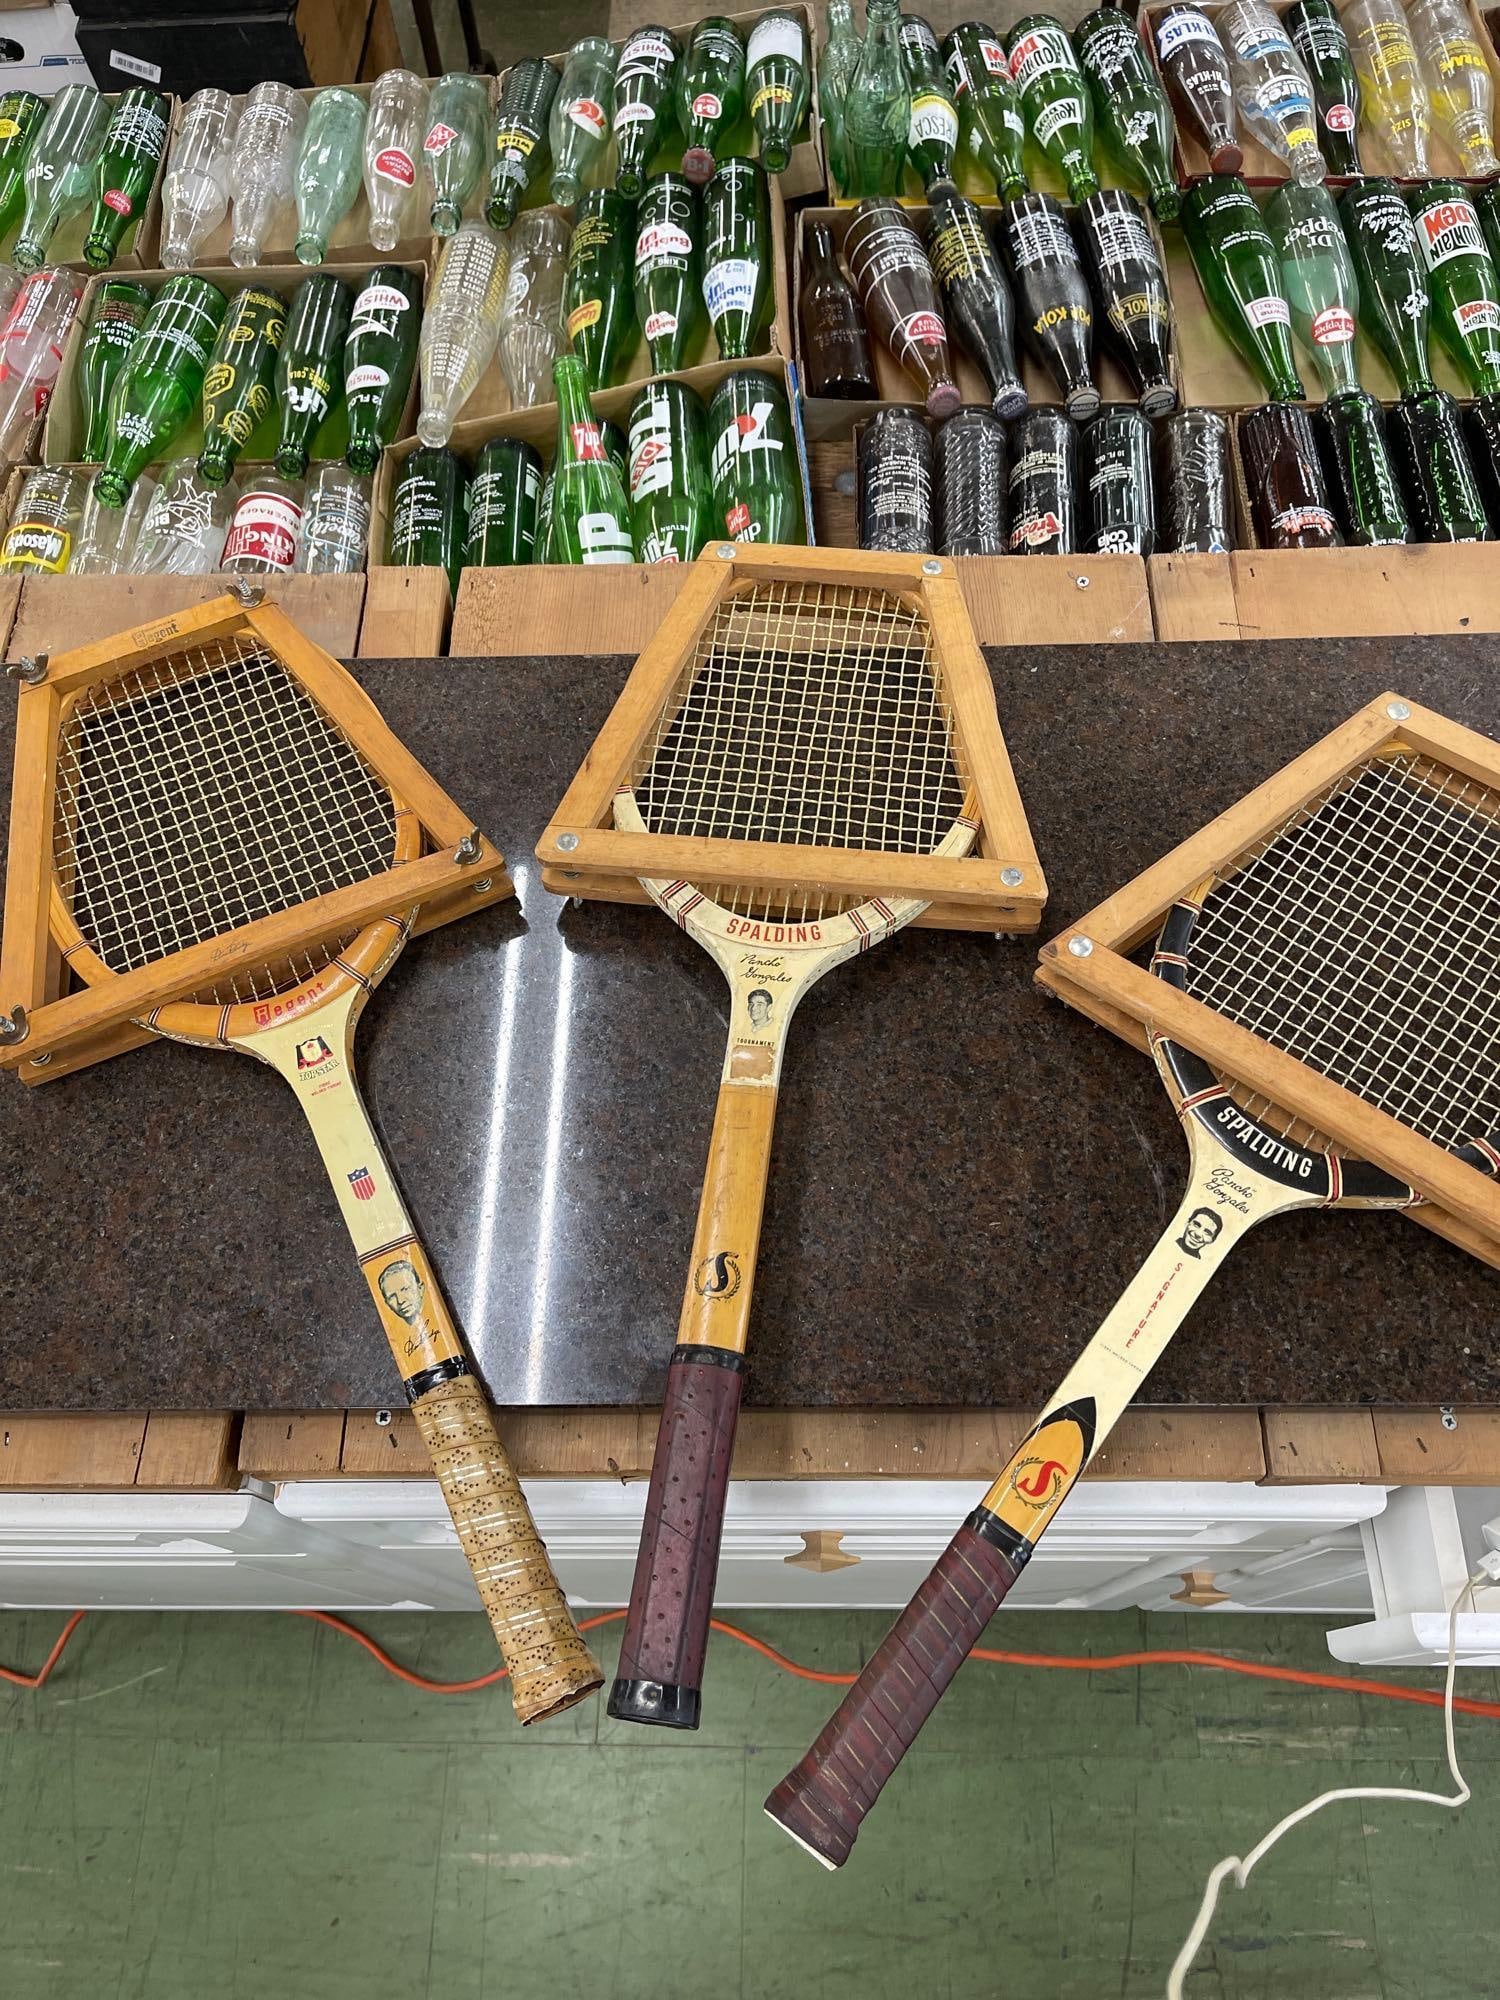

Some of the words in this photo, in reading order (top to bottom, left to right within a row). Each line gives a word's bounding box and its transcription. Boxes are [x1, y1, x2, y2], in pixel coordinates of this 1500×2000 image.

[726, 918, 822, 943] SPALDING
[253, 981, 325, 1027] Regent
[736, 1037, 776, 1049] TOURNAMENT
[1216, 1105, 1314, 1179] SPALDING
[1125, 1261, 1183, 1350] SIGNATURE
